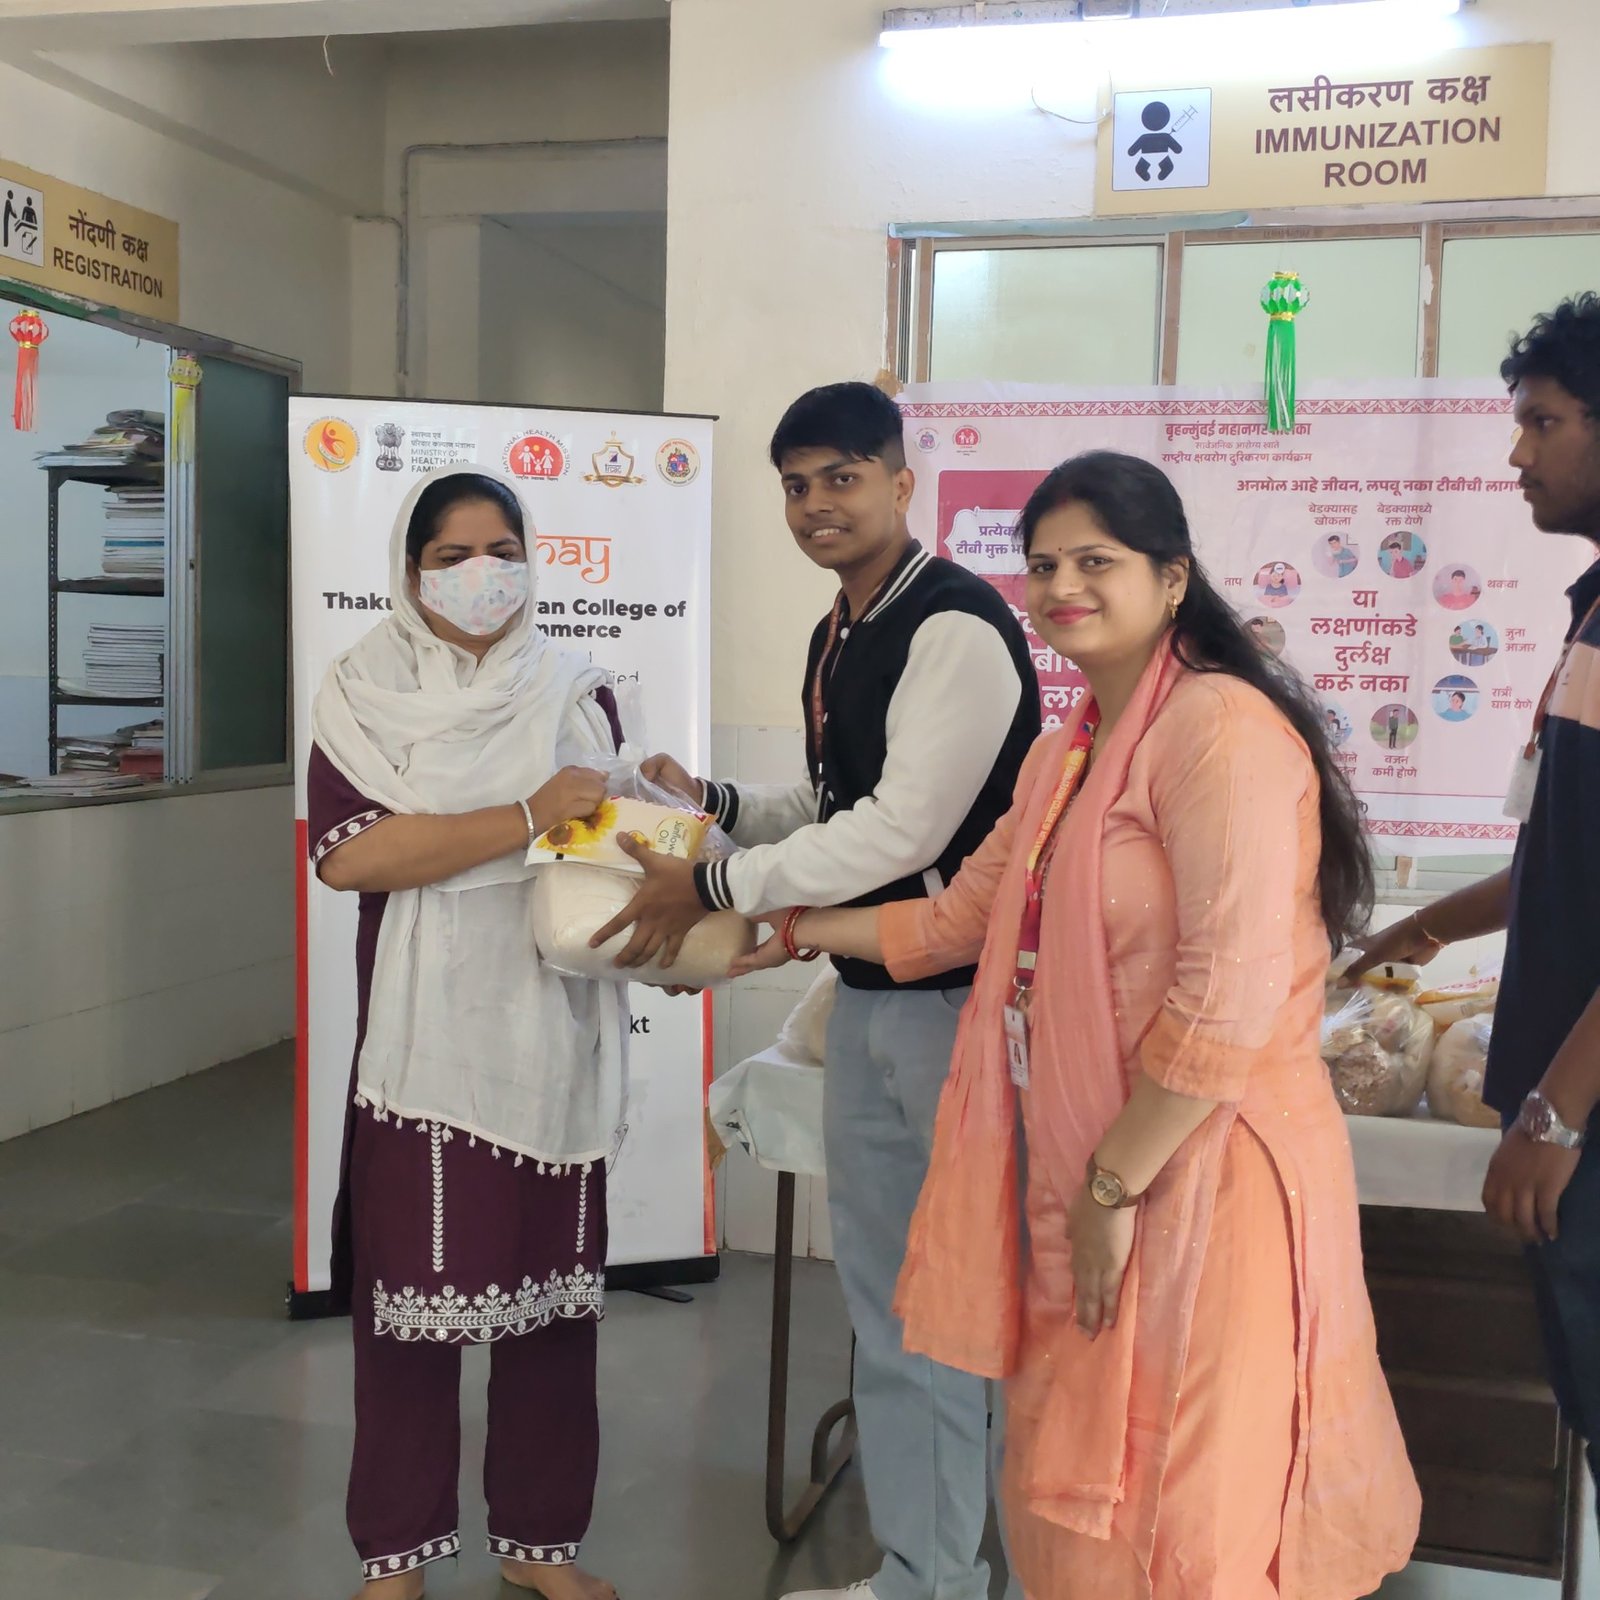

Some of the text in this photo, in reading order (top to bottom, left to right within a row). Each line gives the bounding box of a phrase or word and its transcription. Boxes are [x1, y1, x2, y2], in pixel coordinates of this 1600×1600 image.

[1268, 74, 1492, 113] लसीकरण कक्ष
[1255, 117, 1501, 154] IMMUNIZATION
[1323, 158, 1427, 188] ROOM
[68, 209, 149, 263] नोंदणी कक्ष
[53, 246, 163, 299] REGISTRATION
[410, 448, 458, 457] MINISTRY OF
[411, 456, 446, 465] HEALTH
[502, 429, 571, 476] NATIONAL HEALTH MISSION
[1194, 450, 1227, 463] क्षयरोग
[1271, 449, 1313, 463] कार्यक्रम
[1237, 476, 1288, 491] अनमोल
[1291, 476, 1319, 493] आहे
[1321, 476, 1362, 493] जीवन,
[1366, 480, 1402, 496] लपवू
[1403, 480, 1434, 492] नका
[1436, 476, 1482, 492] टीबीची
[1314, 514, 1352, 526] खोकला
[1404, 515, 1424, 526] येणे
[956, 540, 983, 554] टीबी
[985, 544, 1009, 559] मुक्त
[1223, 575, 1243, 588] ताप
[1352, 590, 1379, 608] या
[572, 598, 657, 620] College
[663, 600, 687, 617] of
[1310, 613, 1418, 637] लक्षणांकडे
[1505, 628, 1526, 640] जुना
[1333, 640, 1392, 672] दुर्लक्ष
[1505, 642, 1536, 653] आजार
[1358, 674, 1410, 693] नका
[1491, 699, 1532, 710] घाम येणे
[1384, 754, 1409, 765] वजन
[1371, 765, 1394, 777] कमी
[1396, 766, 1418, 778] होणे
[657, 829, 670, 844] Oil
[668, 820, 685, 853] Sunflow
